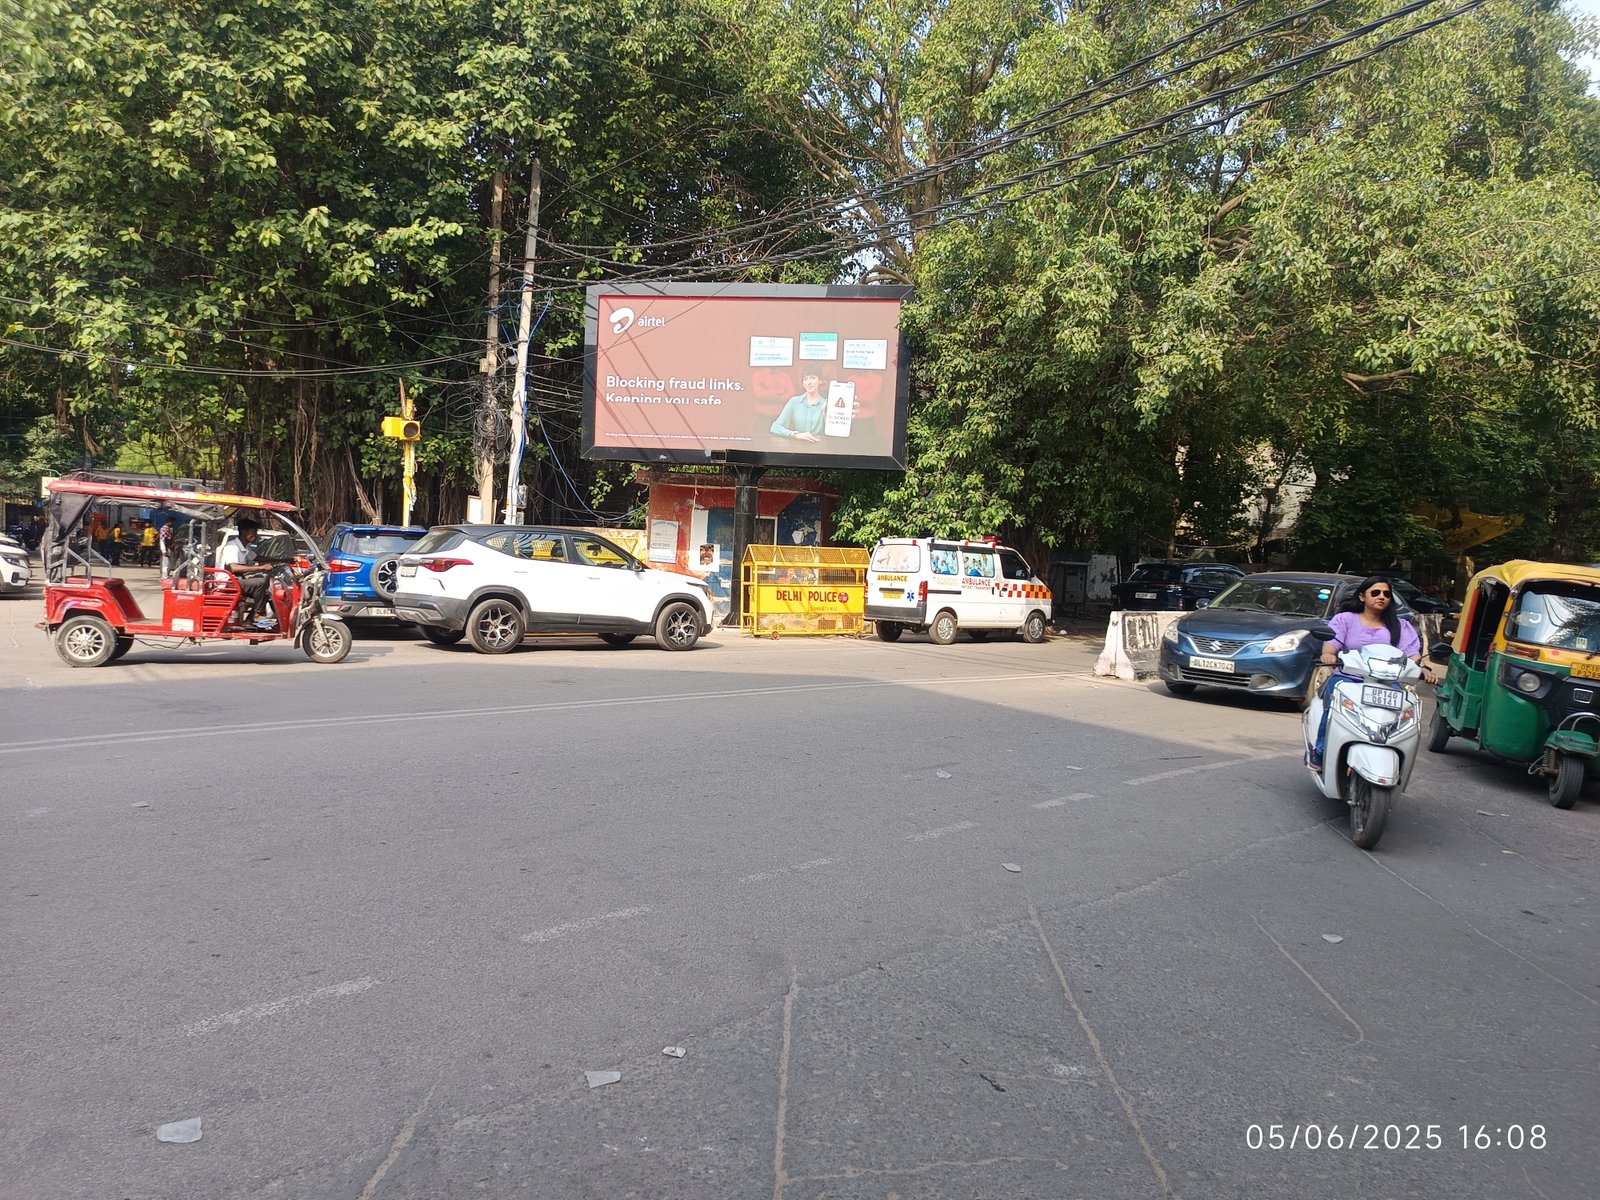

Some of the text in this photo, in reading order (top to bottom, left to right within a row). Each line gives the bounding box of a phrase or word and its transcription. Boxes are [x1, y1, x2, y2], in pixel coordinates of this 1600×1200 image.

[638, 316, 666, 327] airtel
[606, 375, 744, 391] Blocking fraud links.
[877, 574, 908, 583] AMBULANCE
[962, 577, 991, 587] AMBULANCE
[776, 590, 837, 603] DELHI POLICE
